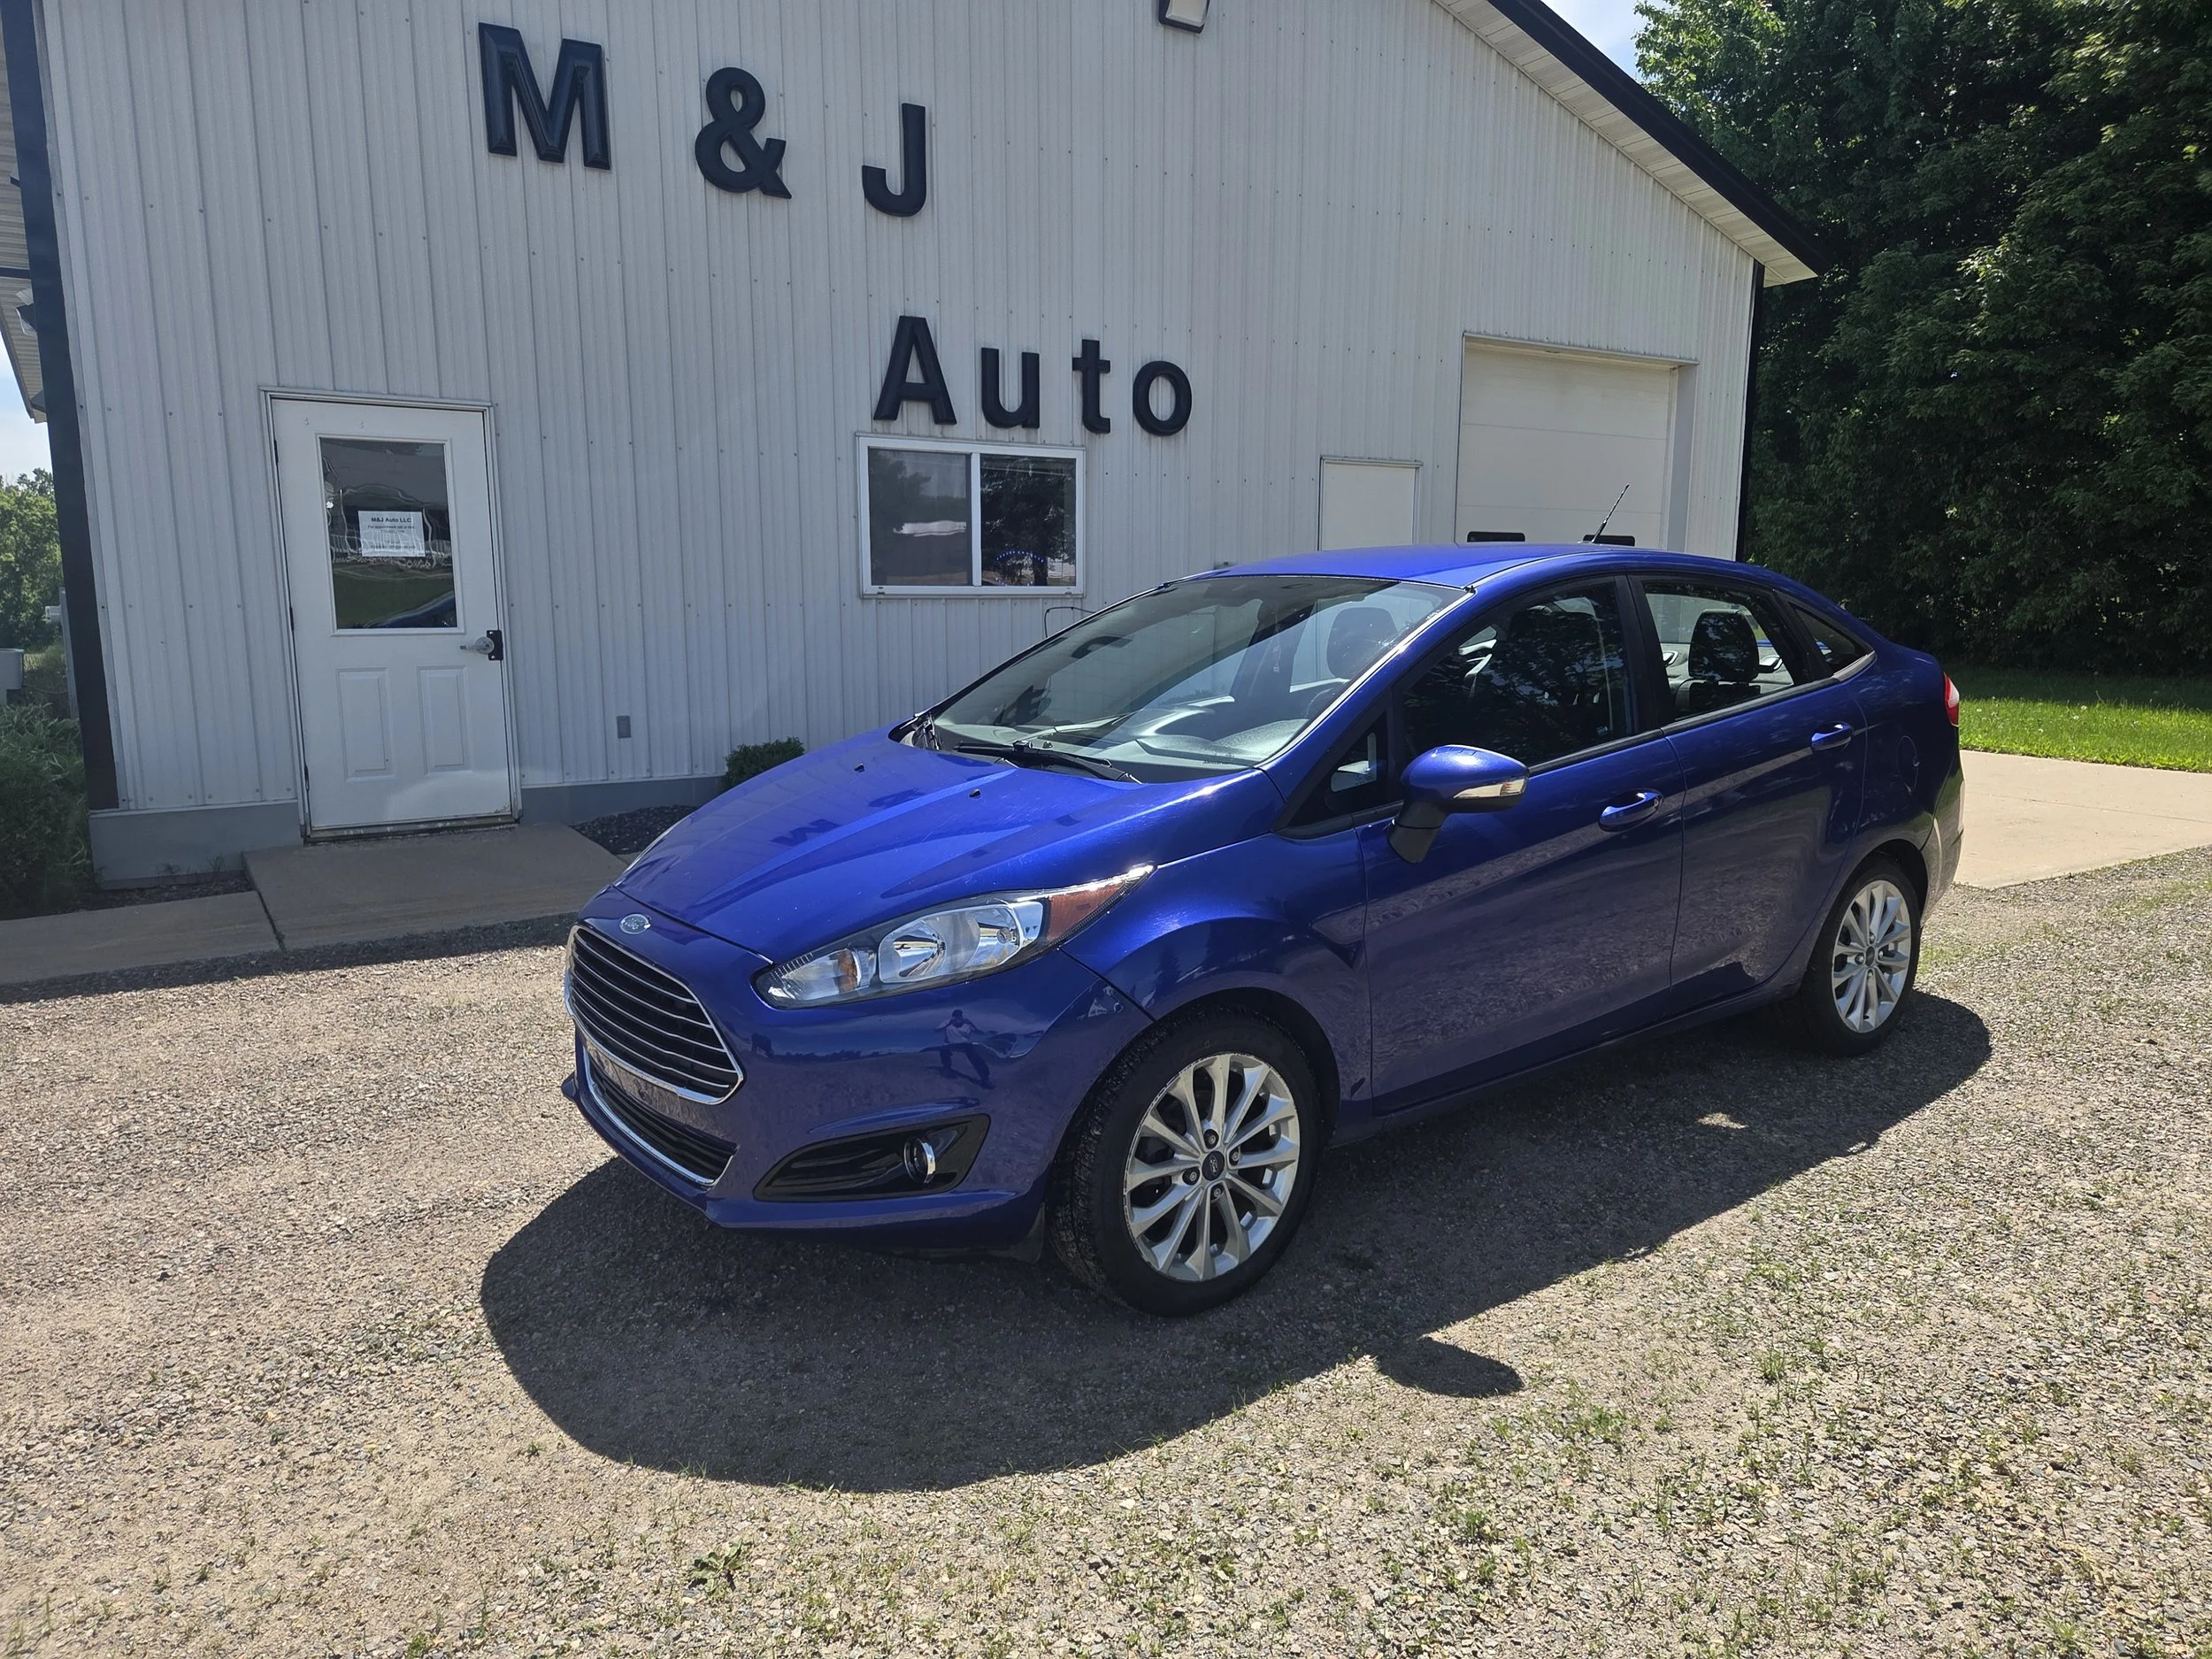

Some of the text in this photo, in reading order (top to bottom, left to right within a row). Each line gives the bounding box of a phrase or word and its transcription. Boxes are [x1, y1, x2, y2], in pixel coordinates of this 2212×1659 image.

[478, 22, 926, 218] M & J
[873, 315, 1193, 436] Auto
